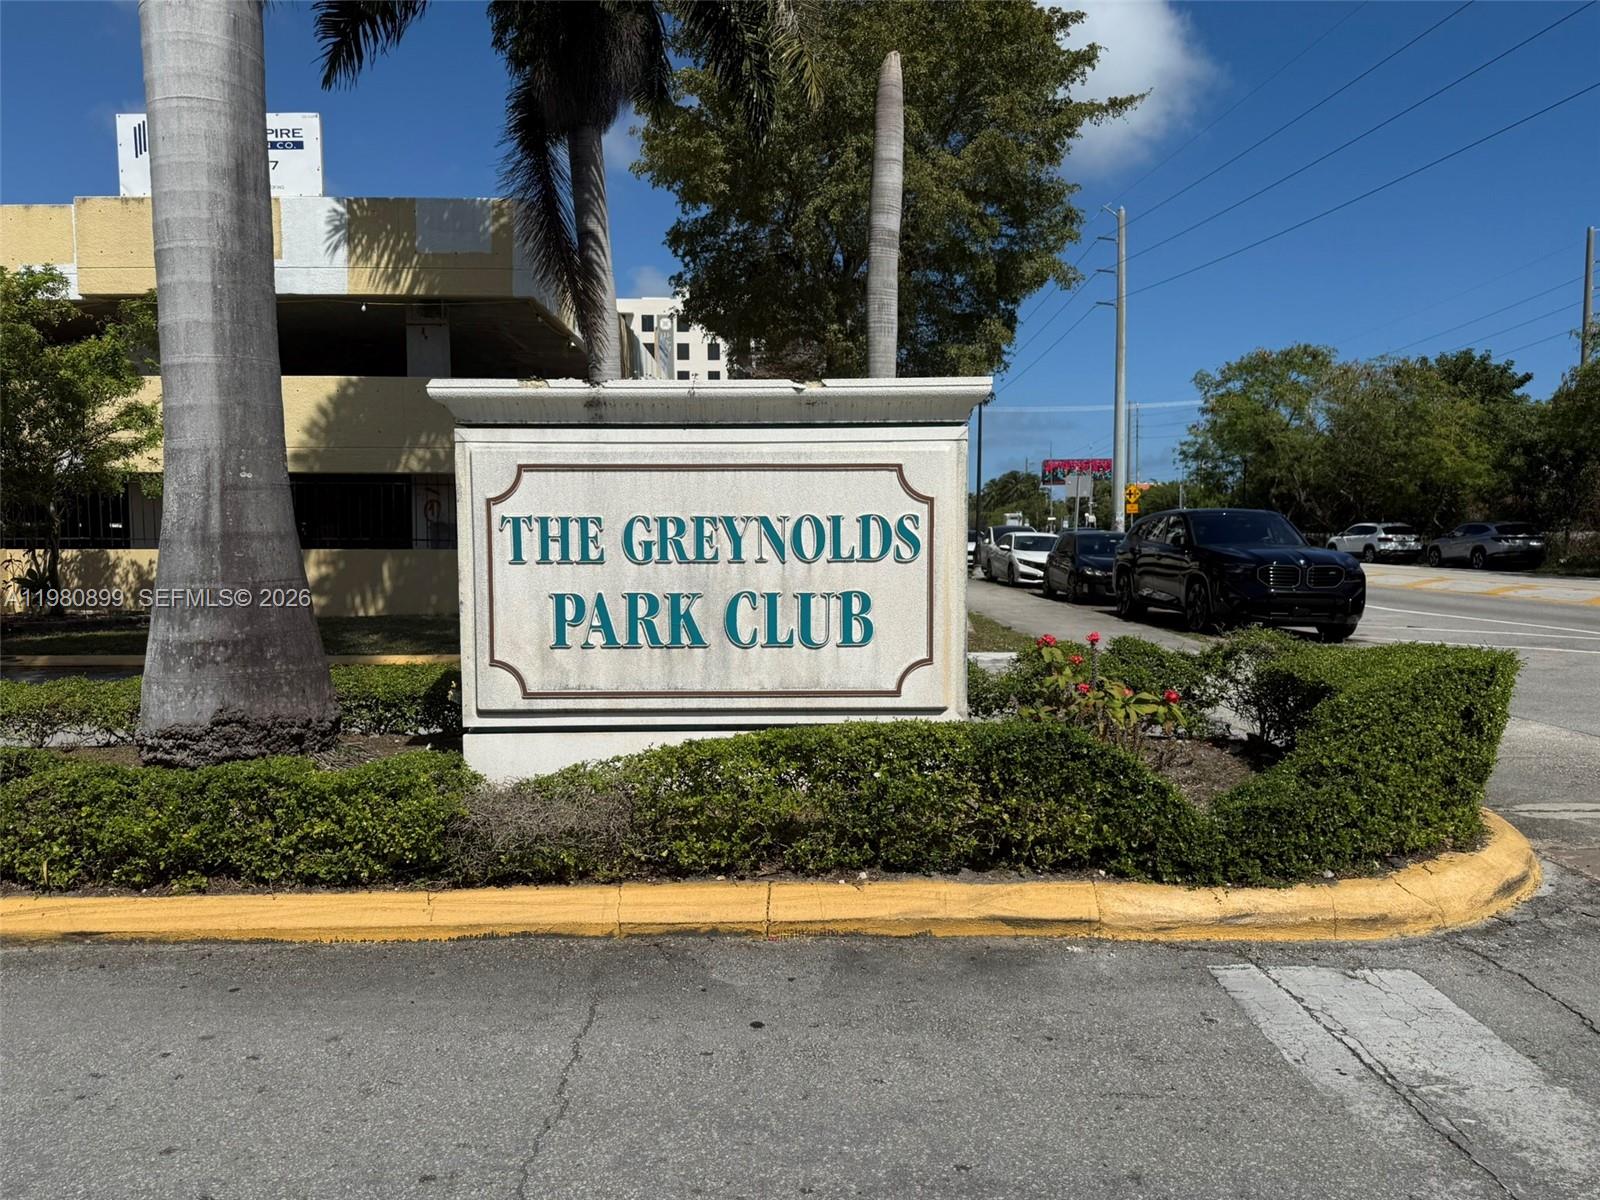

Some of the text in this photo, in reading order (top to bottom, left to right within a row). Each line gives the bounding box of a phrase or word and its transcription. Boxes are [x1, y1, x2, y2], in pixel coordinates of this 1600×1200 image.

[500, 514, 921, 565] THE GREYNOLDS
[550, 590, 875, 649] PARK CLUB
